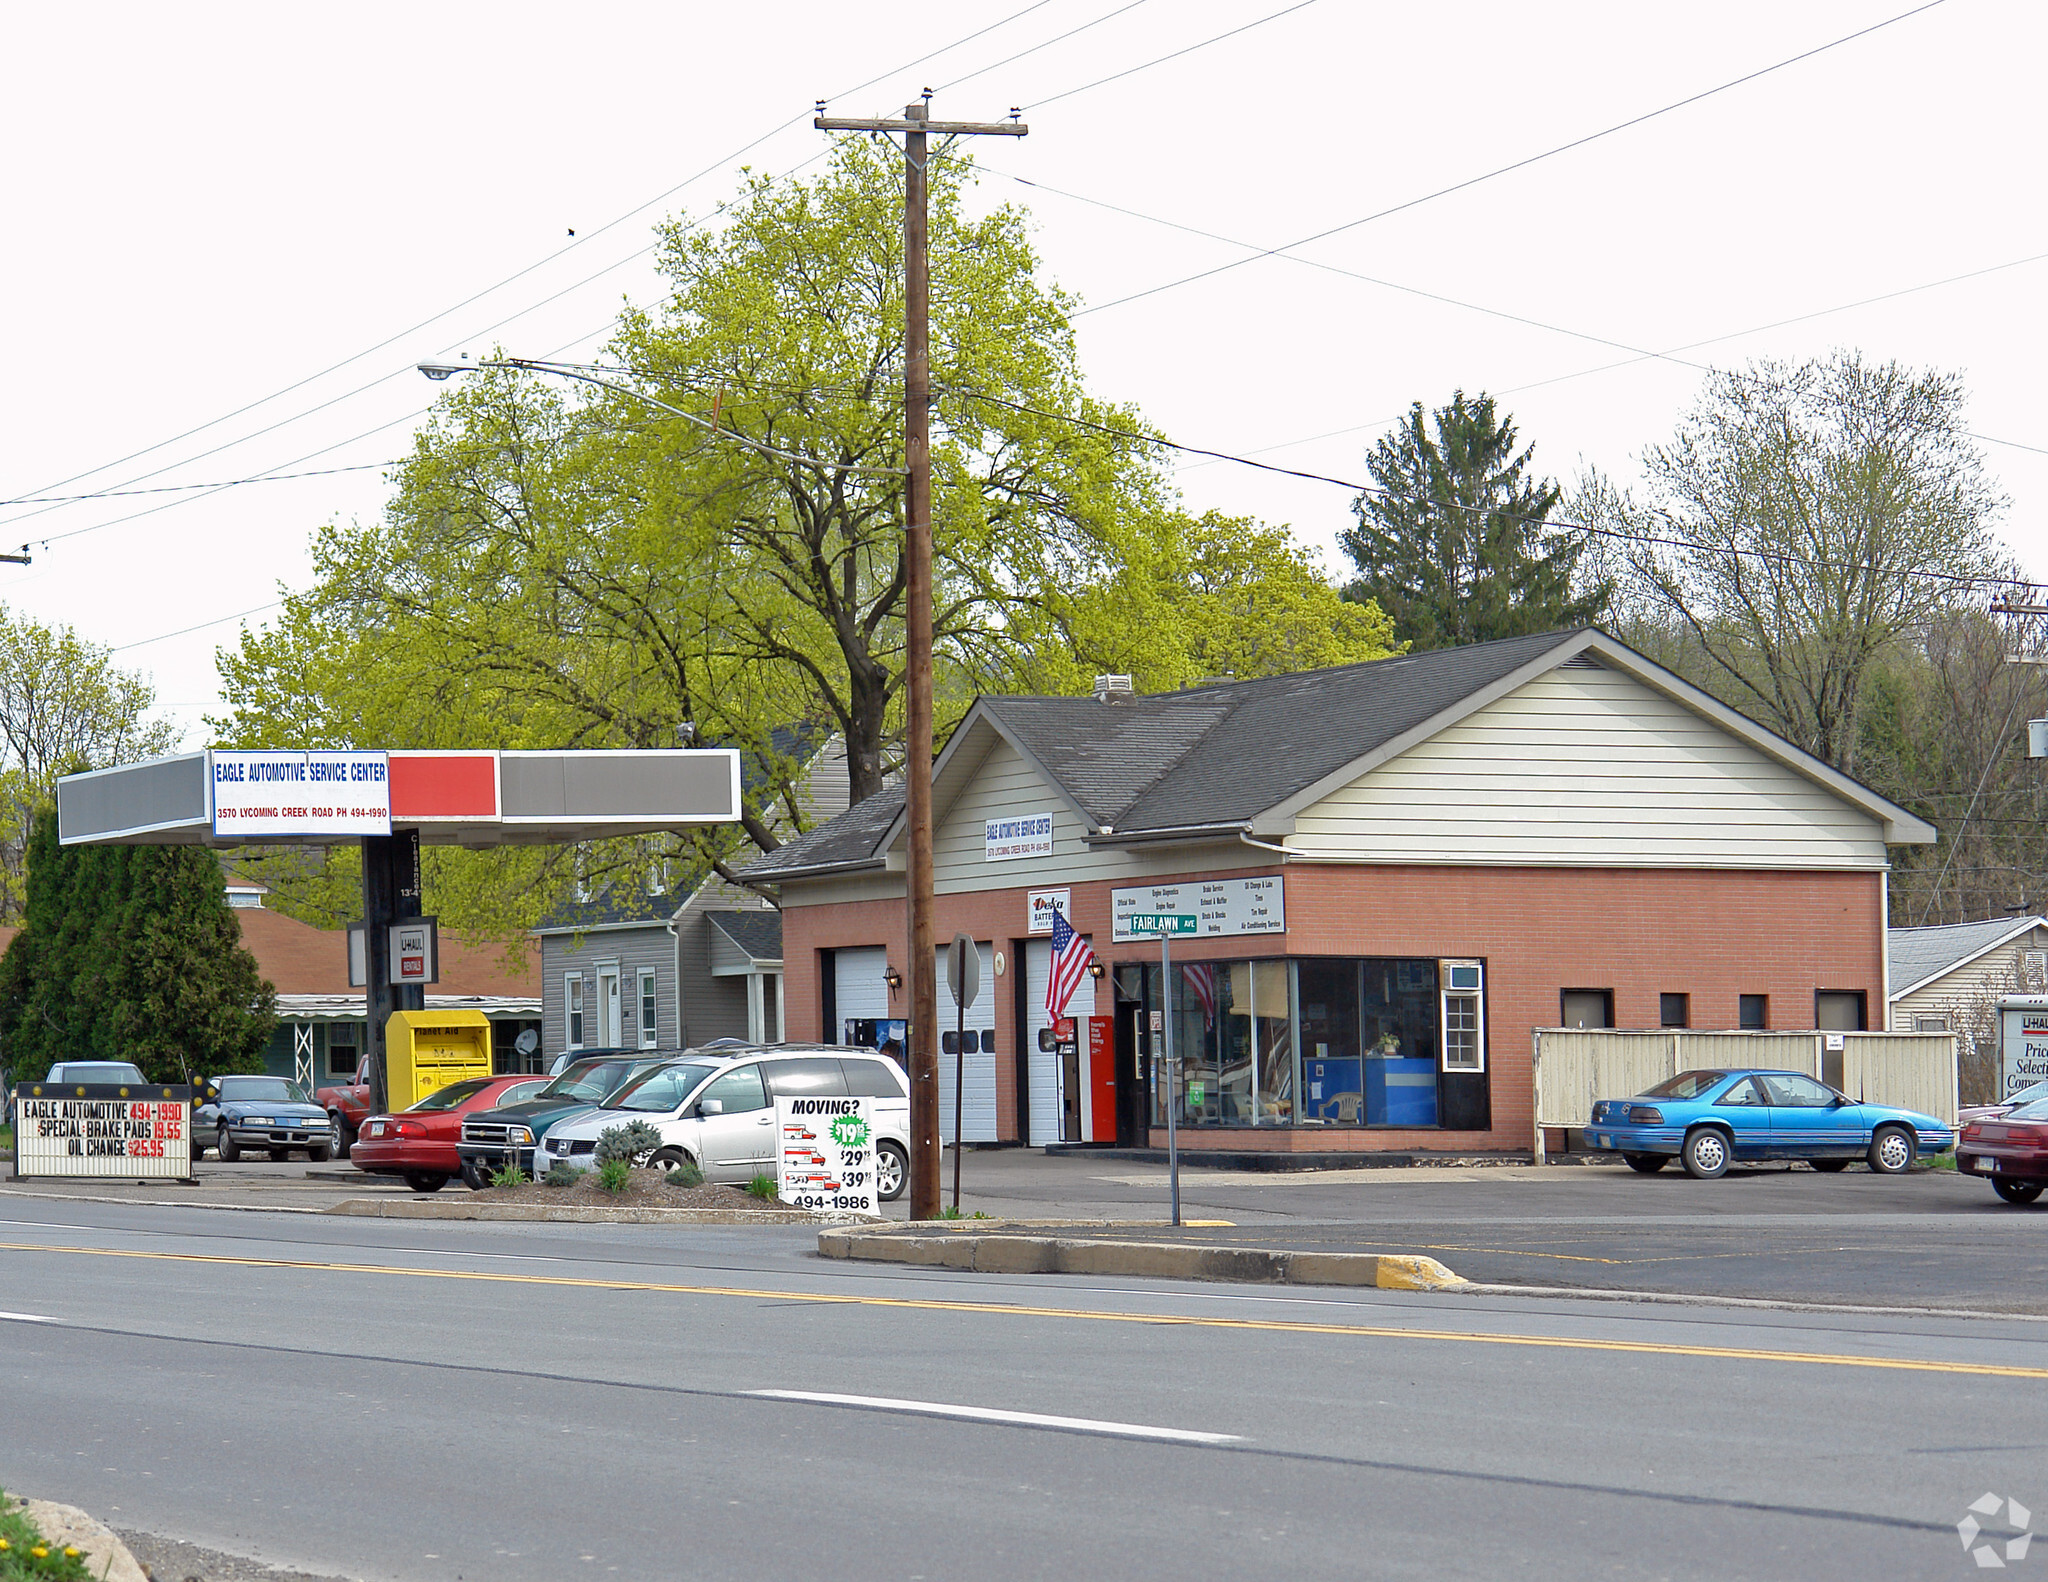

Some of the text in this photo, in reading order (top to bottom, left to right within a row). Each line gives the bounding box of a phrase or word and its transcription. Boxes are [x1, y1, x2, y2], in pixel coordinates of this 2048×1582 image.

[216, 763, 386, 782] EAGLE AUTOMOTIVE SERVICE CENTER
[218, 808, 386, 818] 3570 LYCOMING CREEK ROAD PH 494-1990
[410, 834, 419, 889] Clearance
[1133, 916, 1196, 930] FAIRLAWN AVE
[402, 938, 422, 951] U-HAUL
[403, 960, 421, 971] RENTALS
[415, 1027, 459, 1036] Planet Aid
[24, 1101, 182, 1120] EAGLE AUTOMOTIVE 494-1990
[792, 1100, 860, 1114] MOVING?
[86, 1121, 121, 1138] BRAKE
[124, 1121, 151, 1138] PADS
[154, 1122, 180, 1139] 19.55
[68, 1139, 164, 1157] OIL CHANGE $25.95
[794, 1196, 869, 1209] 494-1986
